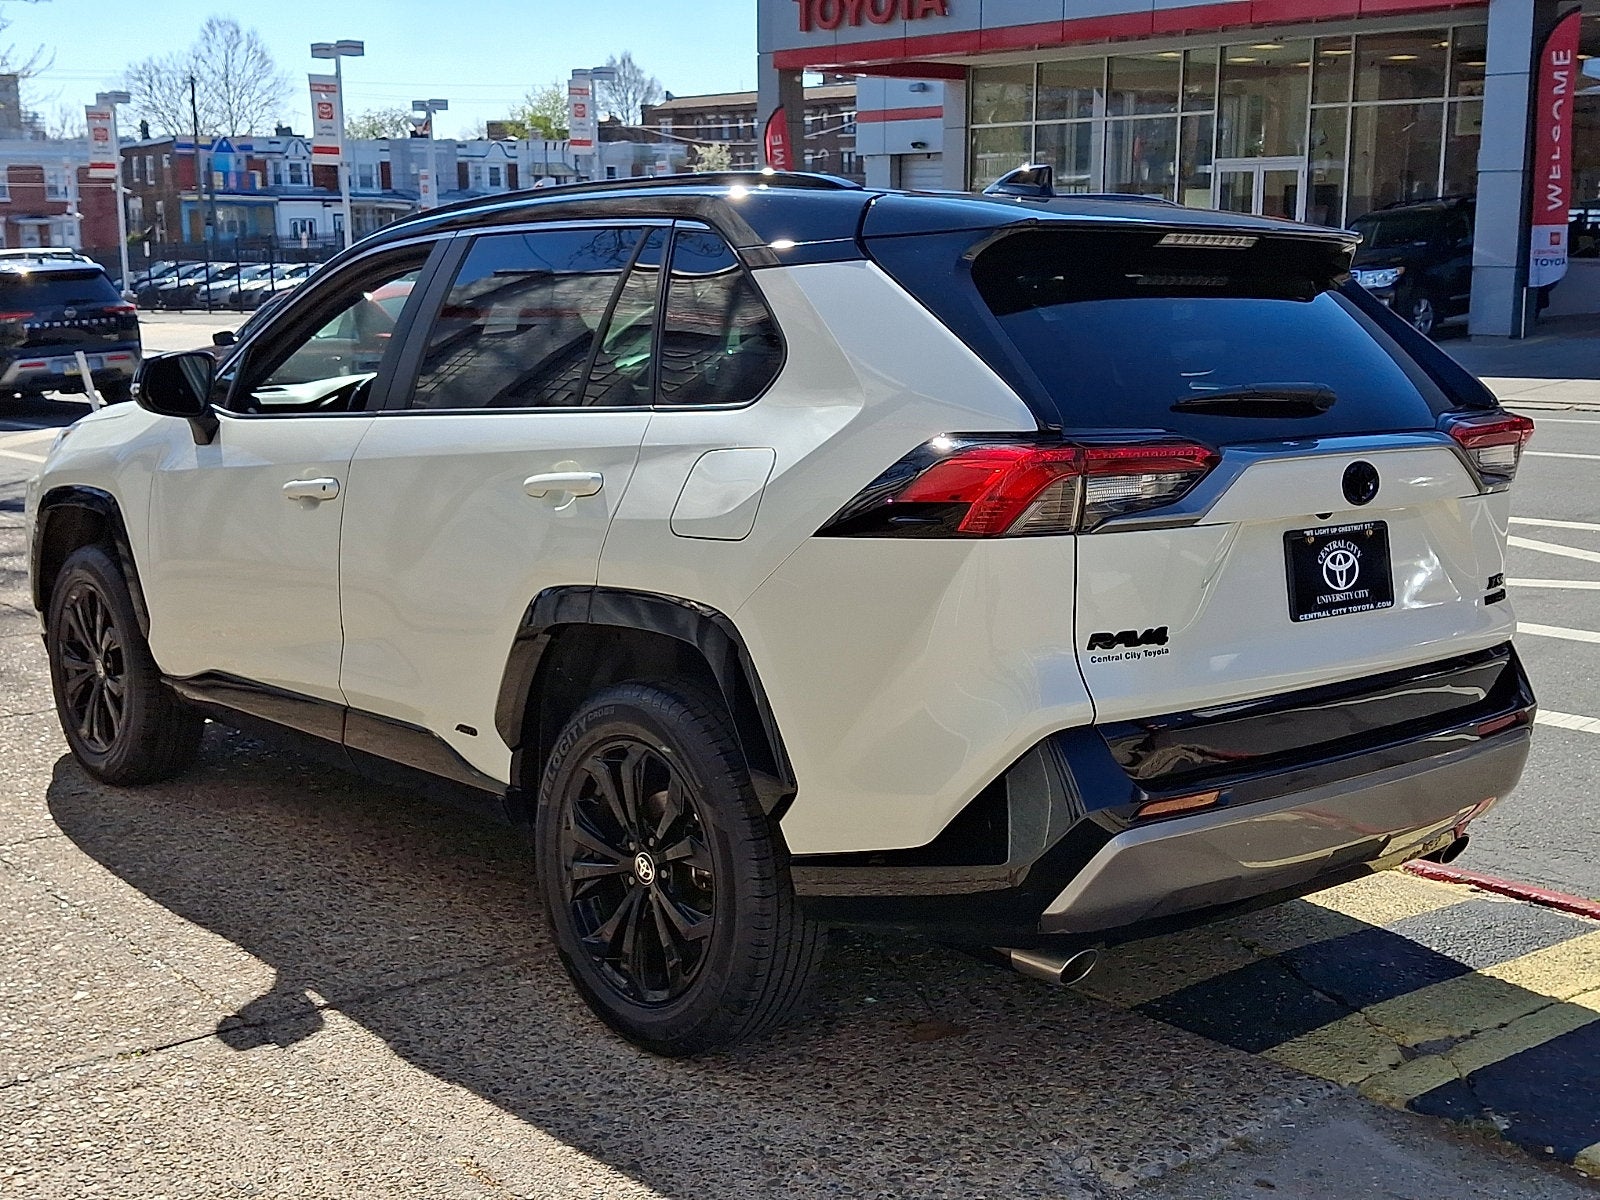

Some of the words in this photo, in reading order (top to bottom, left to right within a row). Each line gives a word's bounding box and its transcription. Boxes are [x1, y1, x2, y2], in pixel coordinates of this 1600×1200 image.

[792, 0, 948, 32] TOYOTA
[1314, 528, 1330, 536] LIGHT
[1317, 540, 1347, 565] CENTRAL
[1346, 541, 1363, 559] CITY
[1316, 591, 1354, 605] UNIVERSITY
[1354, 589, 1370, 598] CITY
[1299, 610, 1331, 621] CENTRAL
[1331, 607, 1347, 616] CITY
[1348, 604, 1375, 613] TOYOTA
[1090, 653, 1123, 664] Central
[1124, 651, 1141, 660] City
[1143, 647, 1169, 658] Toyota
